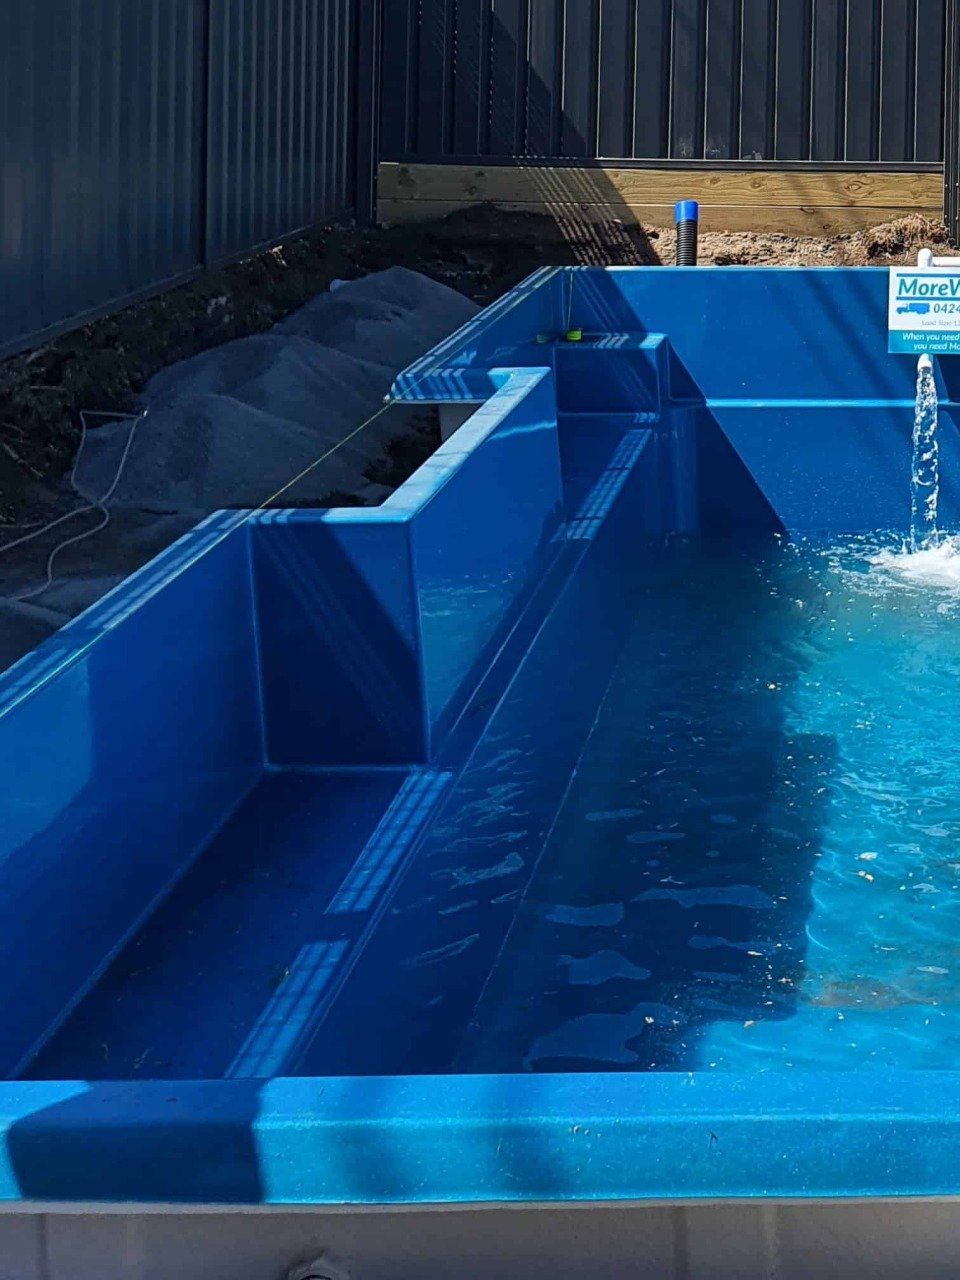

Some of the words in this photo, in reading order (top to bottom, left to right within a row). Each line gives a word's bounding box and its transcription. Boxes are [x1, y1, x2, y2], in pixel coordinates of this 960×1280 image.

[902, 332, 925, 341] When
[926, 334, 940, 342] you
[941, 333, 960, 341] need
[913, 343, 927, 351] you
